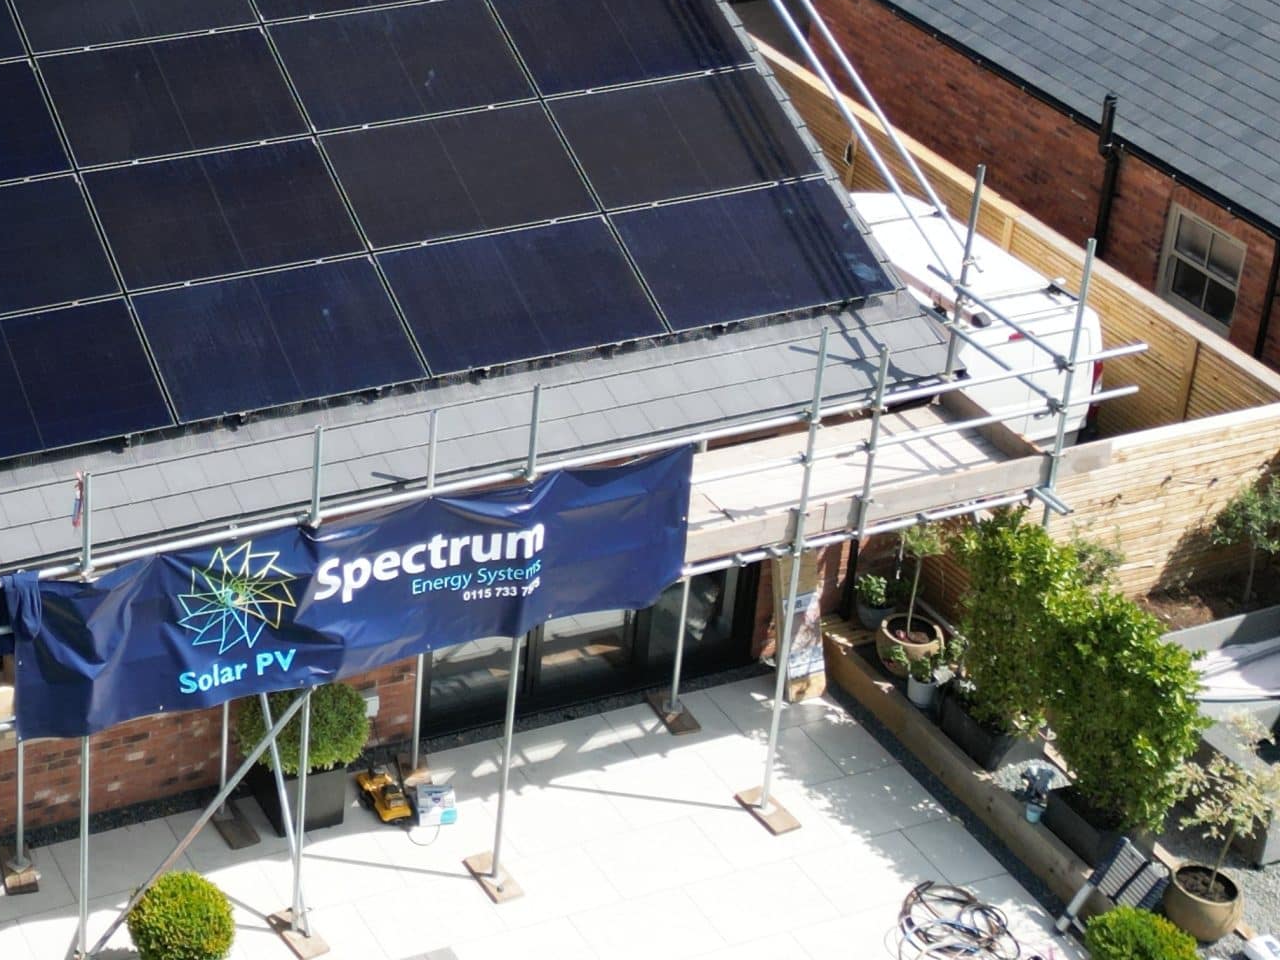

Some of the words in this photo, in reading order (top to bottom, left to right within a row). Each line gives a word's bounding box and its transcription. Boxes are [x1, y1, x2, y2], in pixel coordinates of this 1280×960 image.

[314, 523, 545, 603] Spectrum
[412, 572, 473, 595] Energy
[477, 559, 542, 585] Systems
[463, 588, 492, 601] 0115
[495, 586, 518, 597] 733
[179, 663, 248, 694] Solar
[256, 648, 297, 676] PV
